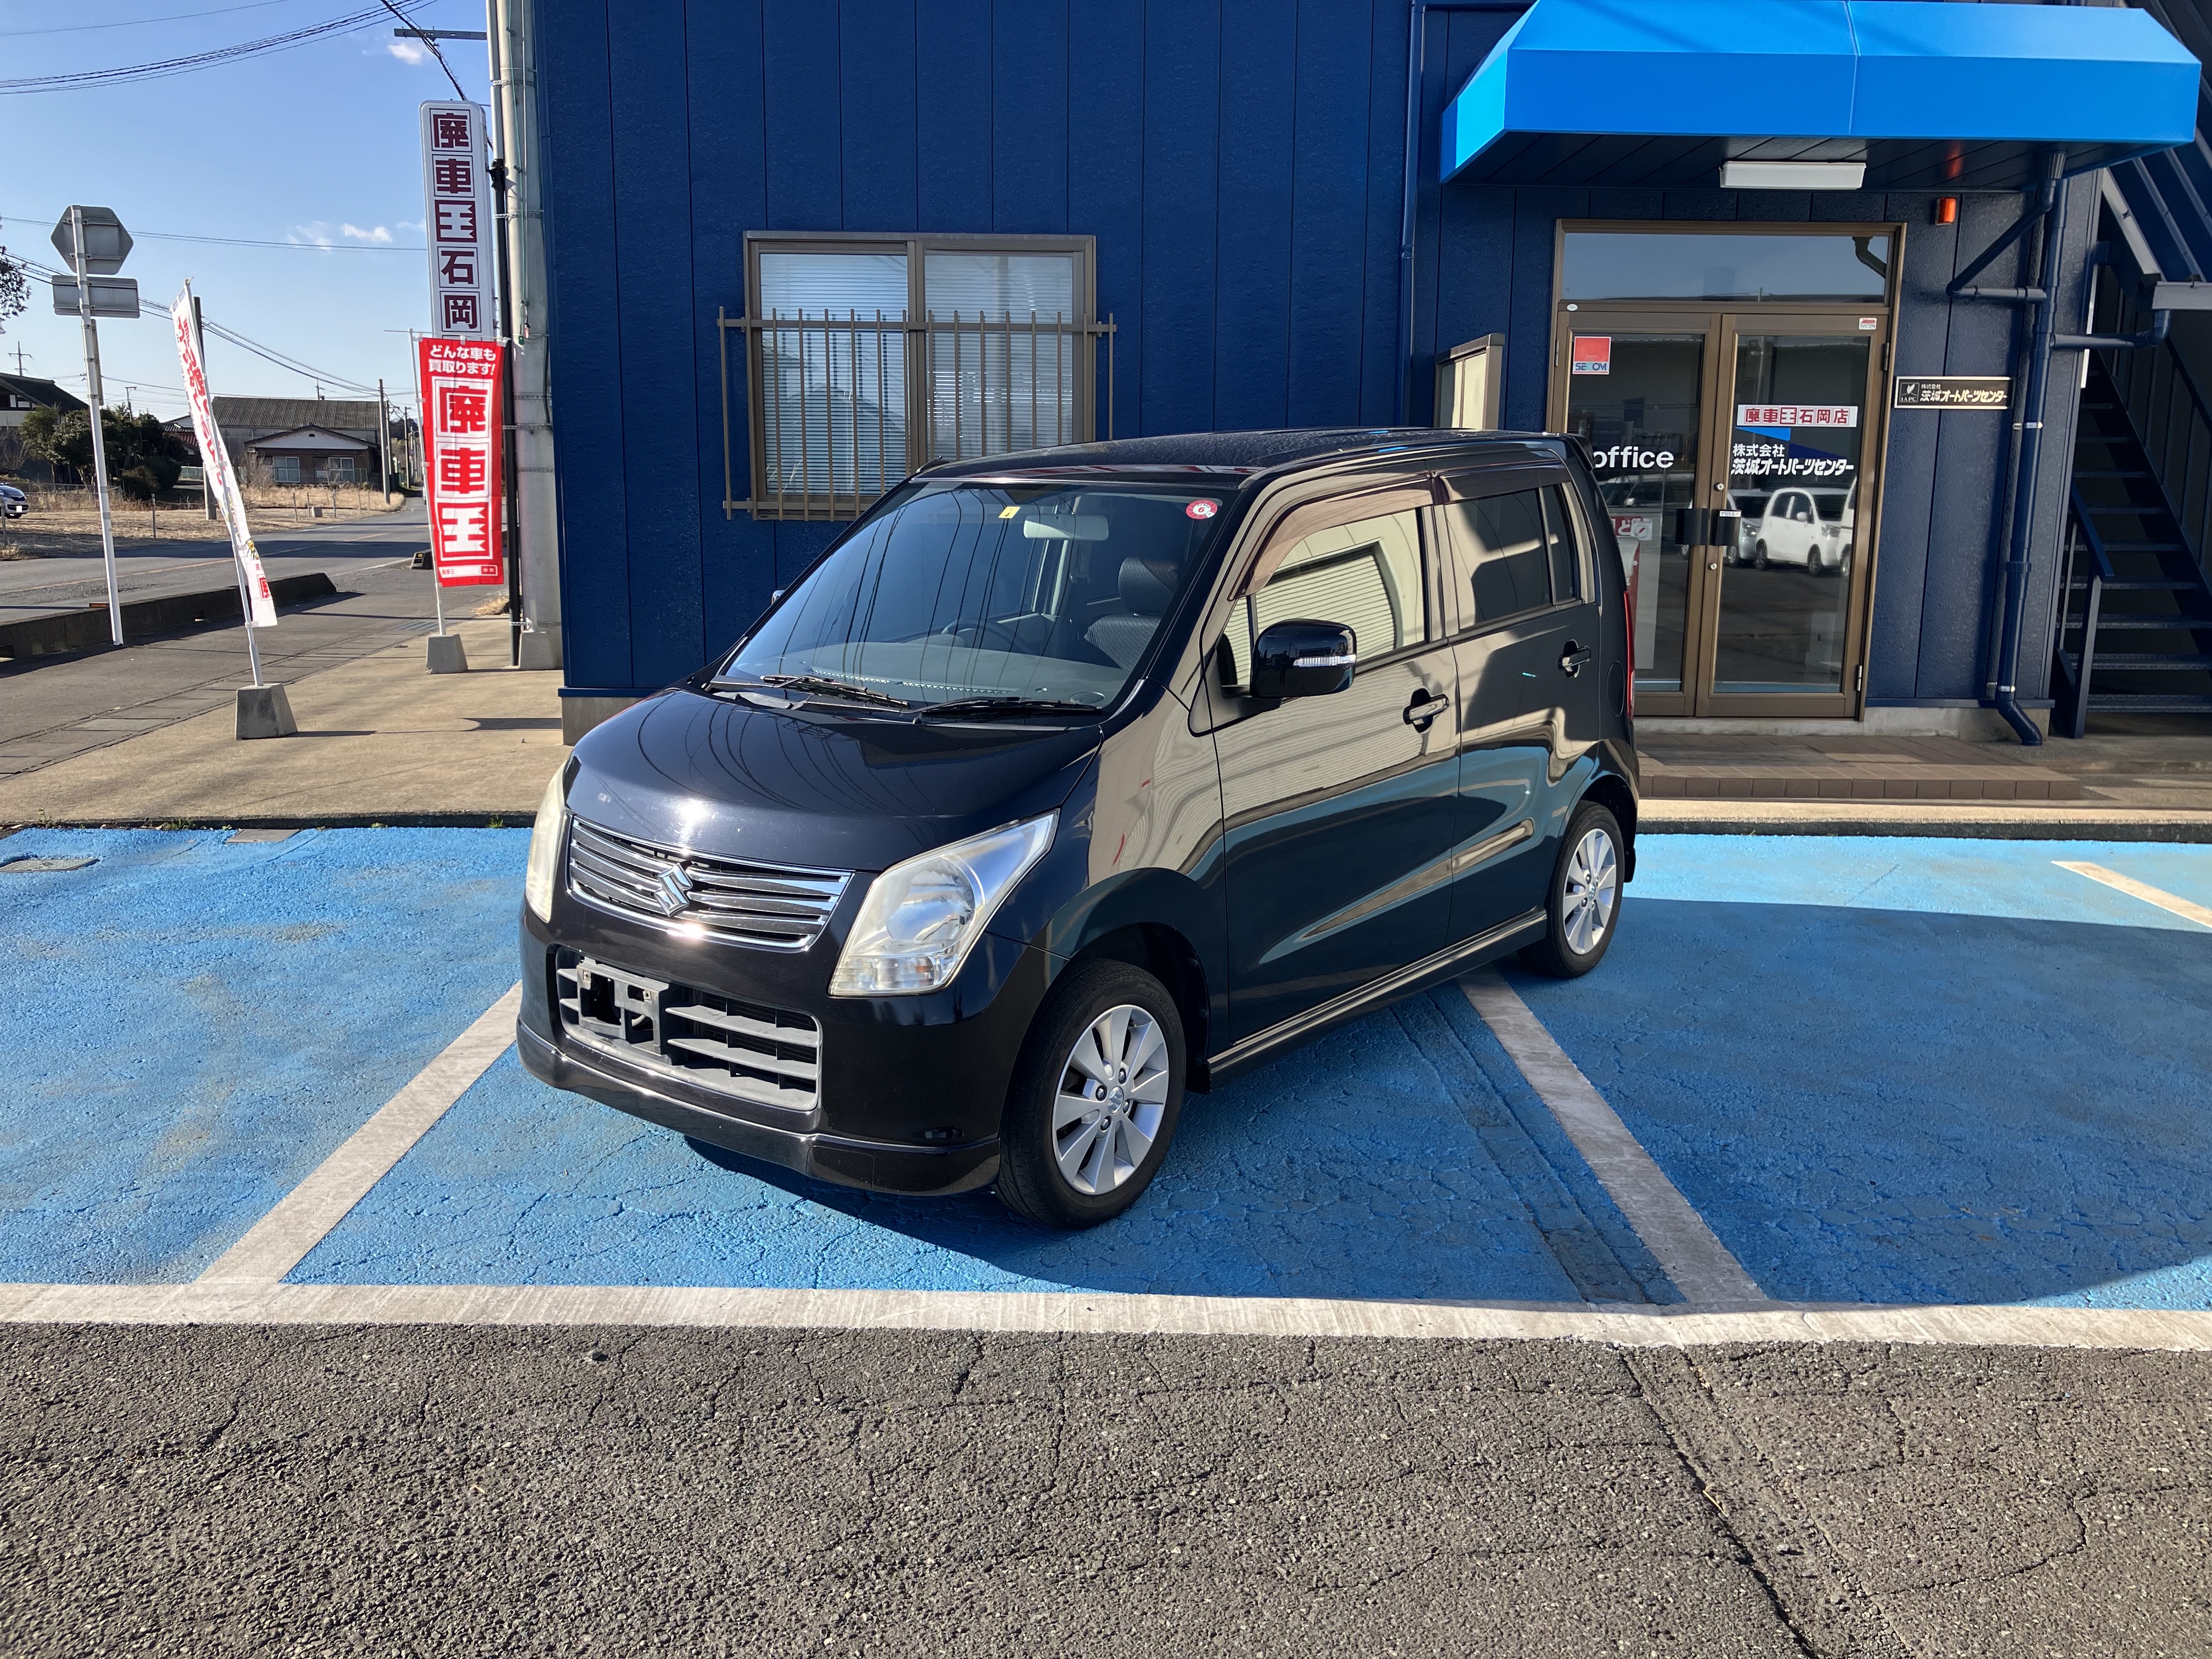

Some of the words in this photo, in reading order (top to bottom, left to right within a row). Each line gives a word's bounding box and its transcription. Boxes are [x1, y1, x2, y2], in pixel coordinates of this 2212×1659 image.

[430, 345, 496, 362] どんな車も
[428, 358, 496, 376] 買取ります!
[1575, 362, 1607, 371] SECOM
[1920, 389, 2007, 403] 茨城オートパーツセンター
[1745, 407, 1850, 425] 廃車王石岡店
[1593, 445, 1674, 469] office
[1733, 443, 1785, 458] 株式会社
[438, 385, 489, 557] 廃車王
[1730, 458, 1854, 476] 茨城オートパーツセンター
